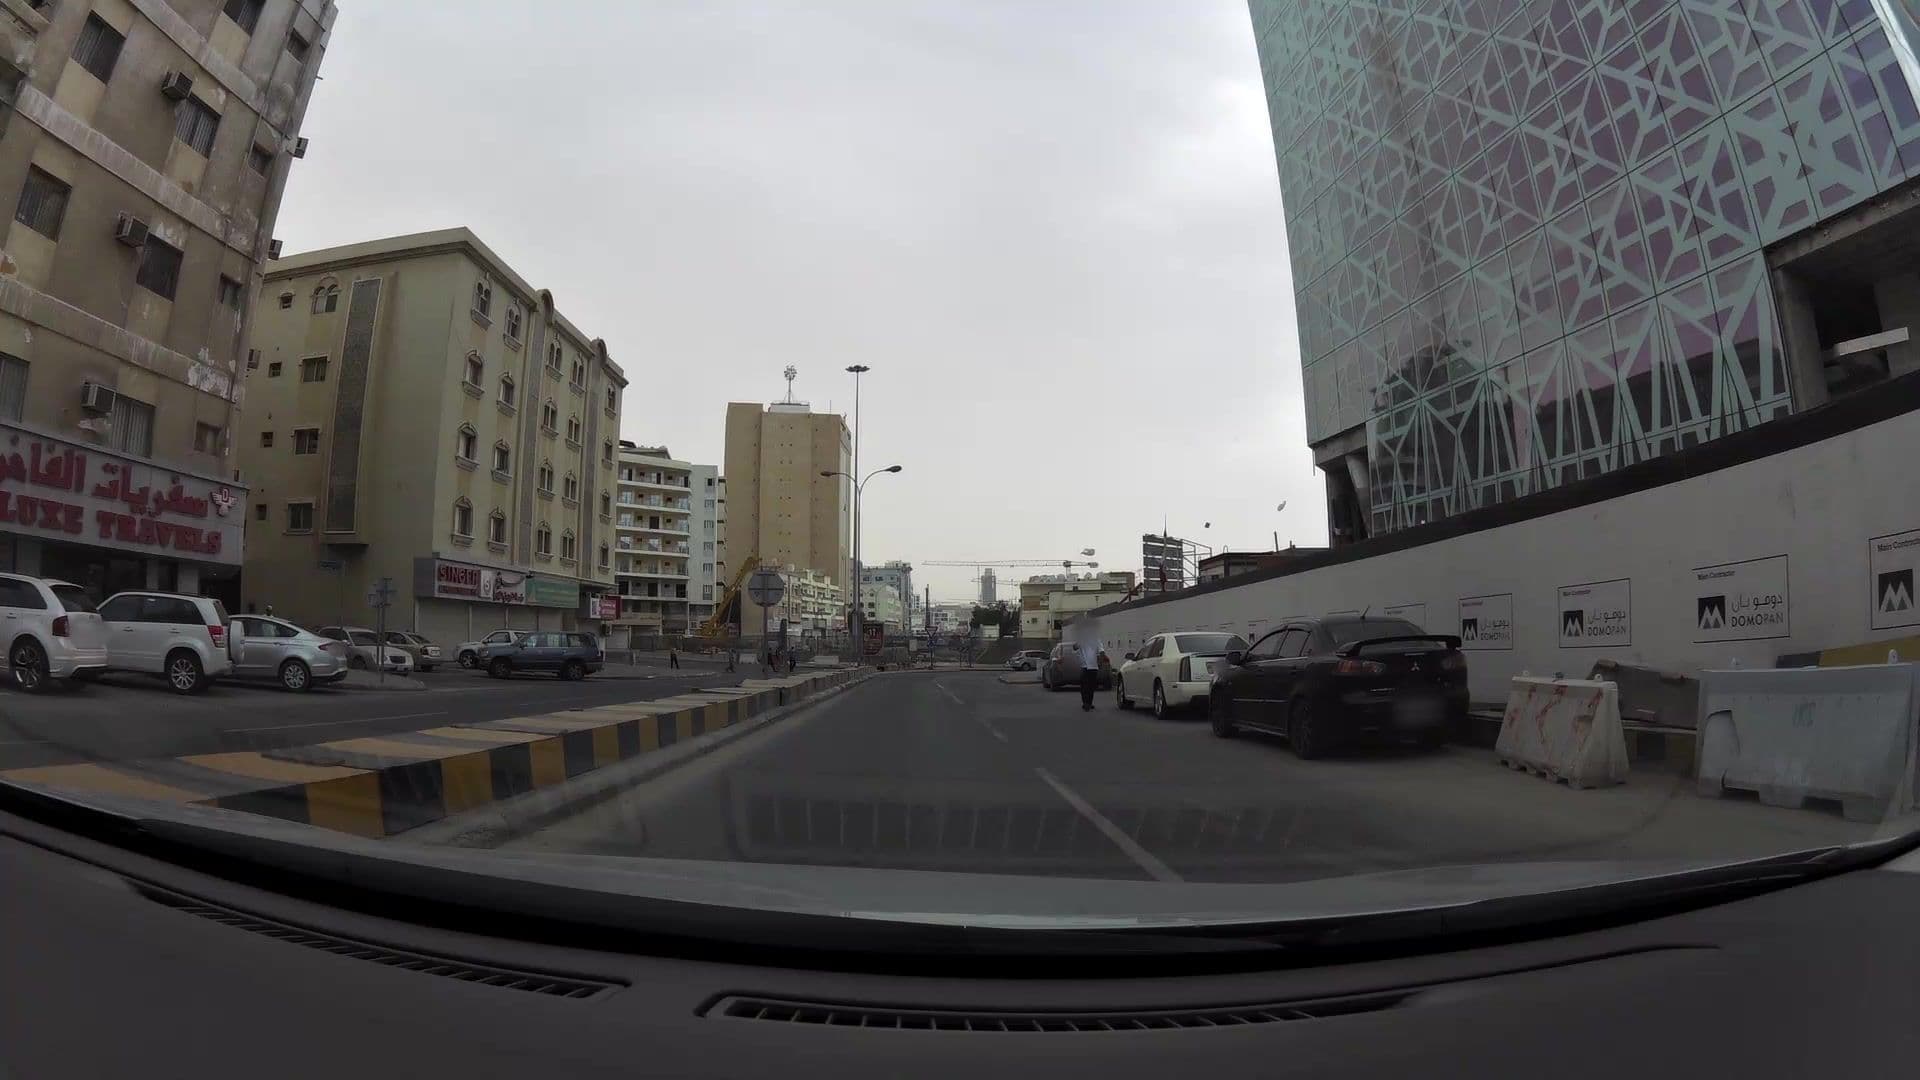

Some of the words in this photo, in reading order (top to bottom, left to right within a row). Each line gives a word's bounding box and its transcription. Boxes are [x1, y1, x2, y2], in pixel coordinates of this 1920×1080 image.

[96, 510, 222, 554] TRAVELS
[1731, 612, 1784, 627] DOMOPAN
[1587, 625, 1627, 637] DOMOPAN
